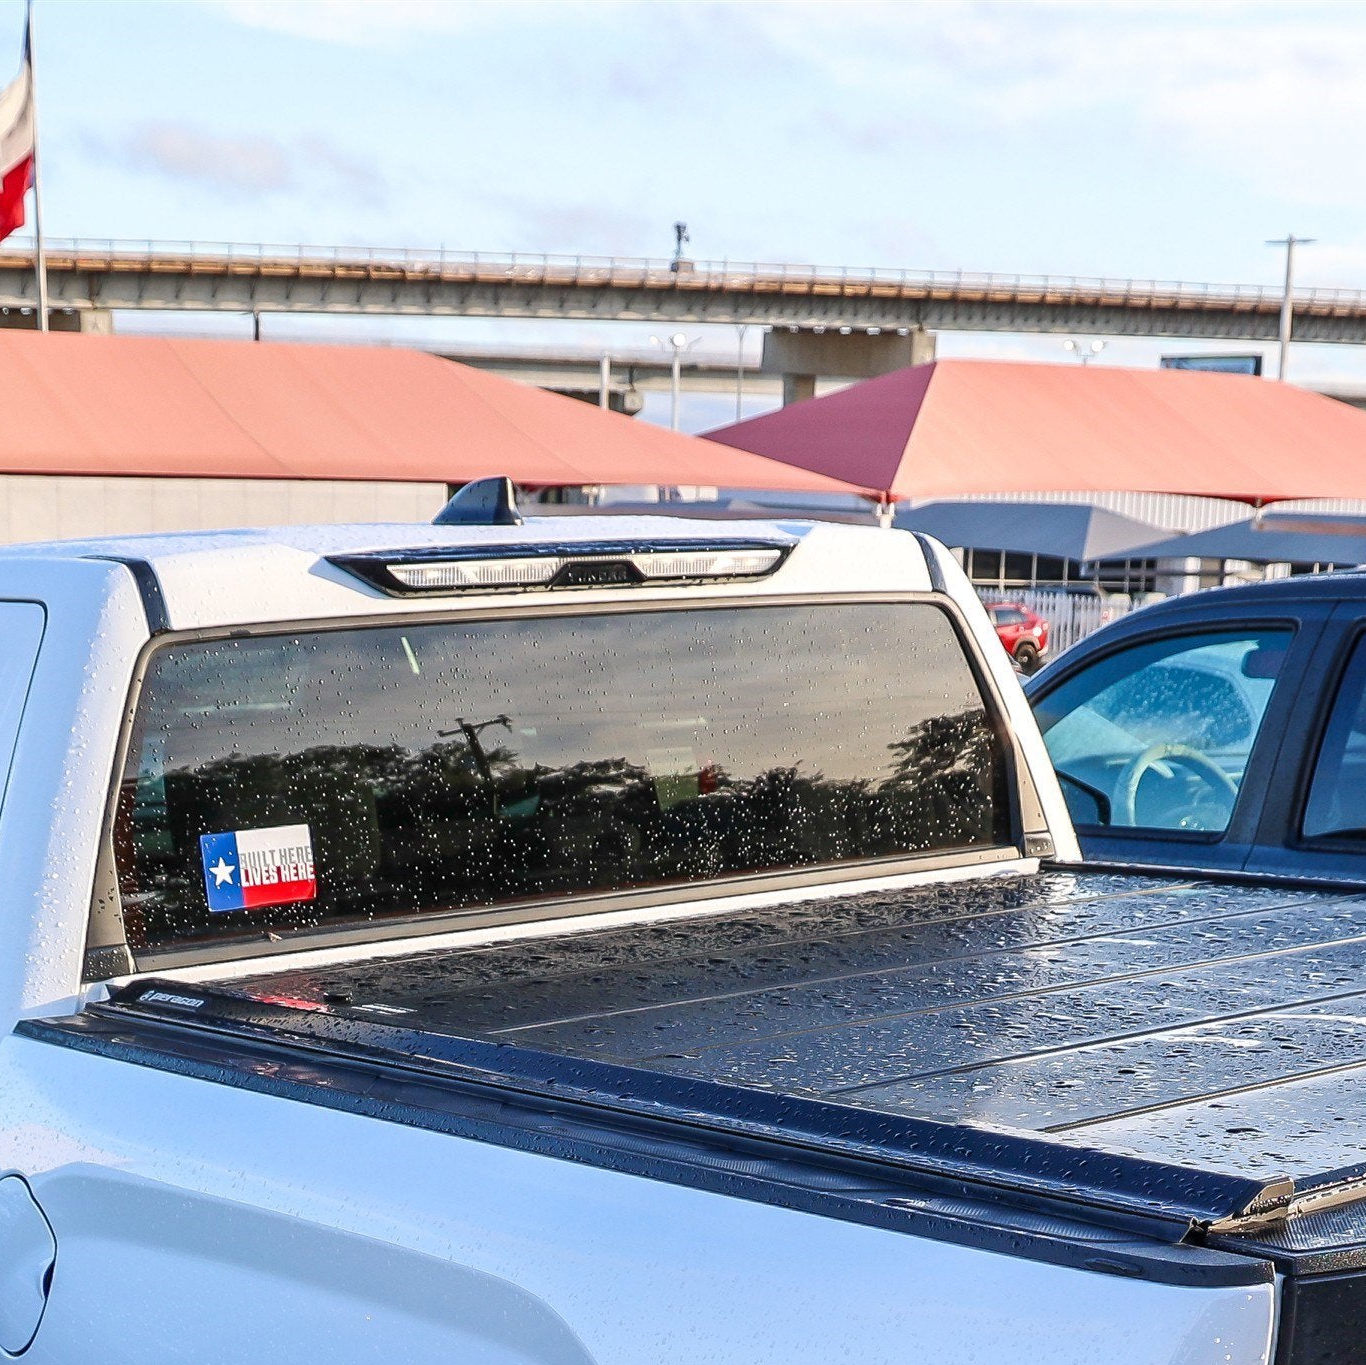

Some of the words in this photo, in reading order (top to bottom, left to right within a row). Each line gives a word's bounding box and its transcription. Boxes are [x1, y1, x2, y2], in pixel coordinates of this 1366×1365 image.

[239, 850, 276, 869] BUILT
[279, 845, 312, 866] HERE
[241, 865, 279, 887] LIVES
[280, 862, 315, 883] HERE
